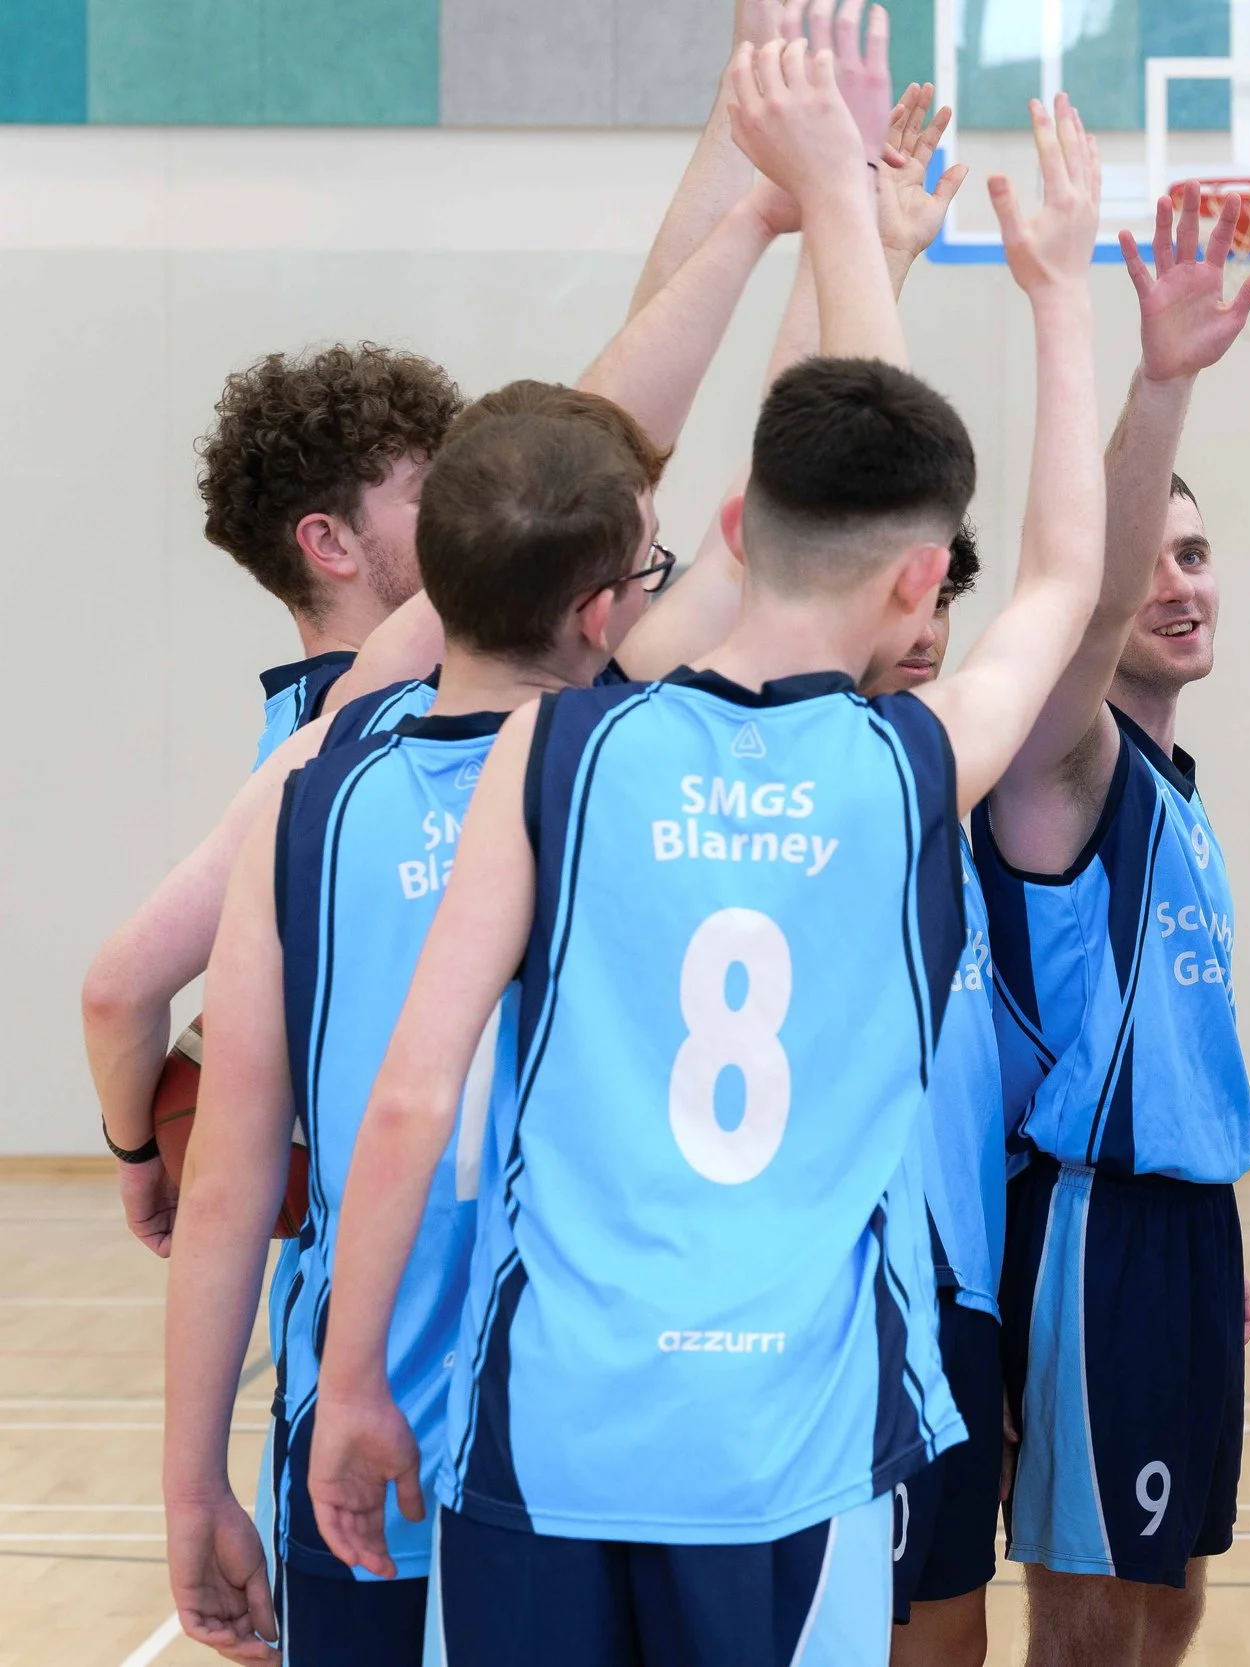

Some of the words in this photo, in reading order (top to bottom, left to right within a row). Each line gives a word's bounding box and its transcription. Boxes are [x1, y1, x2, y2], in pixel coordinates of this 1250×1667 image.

[680, 774, 816, 819] SMGS
[652, 817, 840, 877] Blarney
[1191, 823, 1211, 870] 9
[669, 906, 793, 1185] 8
[657, 1330, 787, 1355] azzurri
[1135, 1460, 1171, 1536] 9
